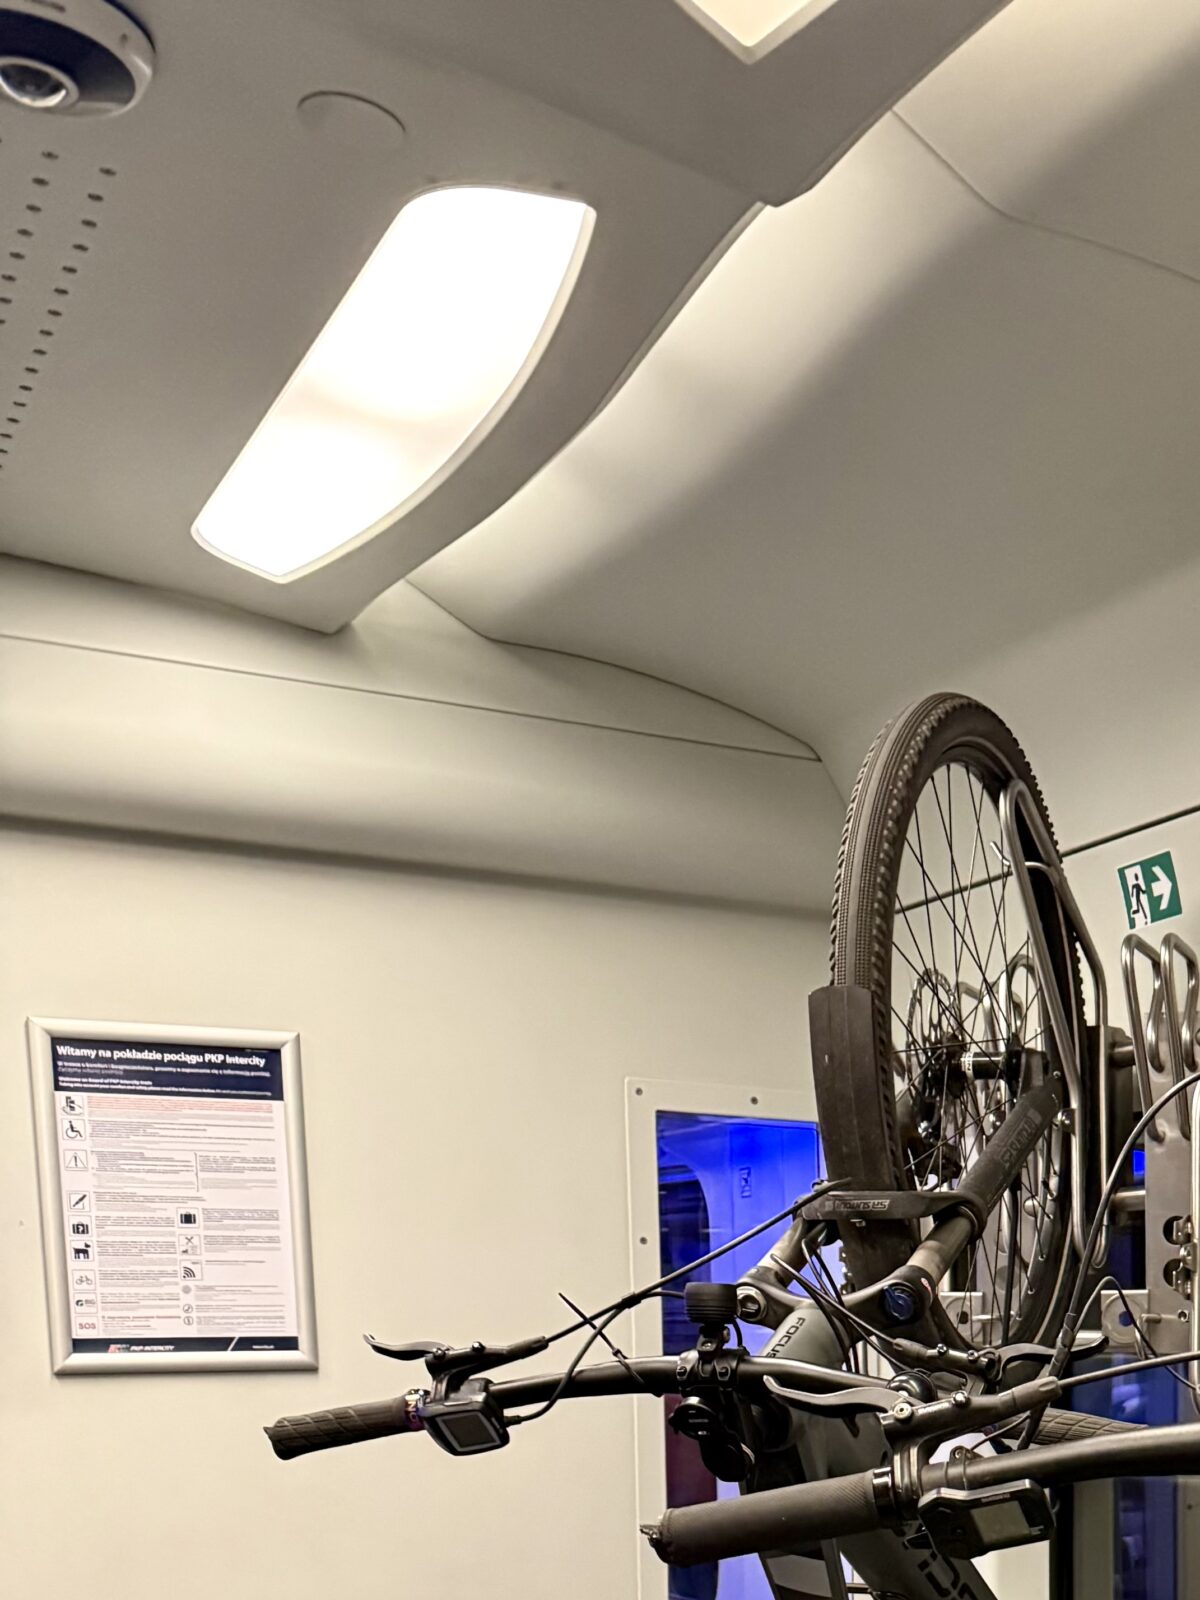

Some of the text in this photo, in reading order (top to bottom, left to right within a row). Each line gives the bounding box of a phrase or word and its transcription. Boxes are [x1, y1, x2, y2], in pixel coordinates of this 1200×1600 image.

[57, 1045, 265, 1067] Witamy na pokładzie pociągu PKP Intercity
[78, 1321, 97, 1330] SOS
